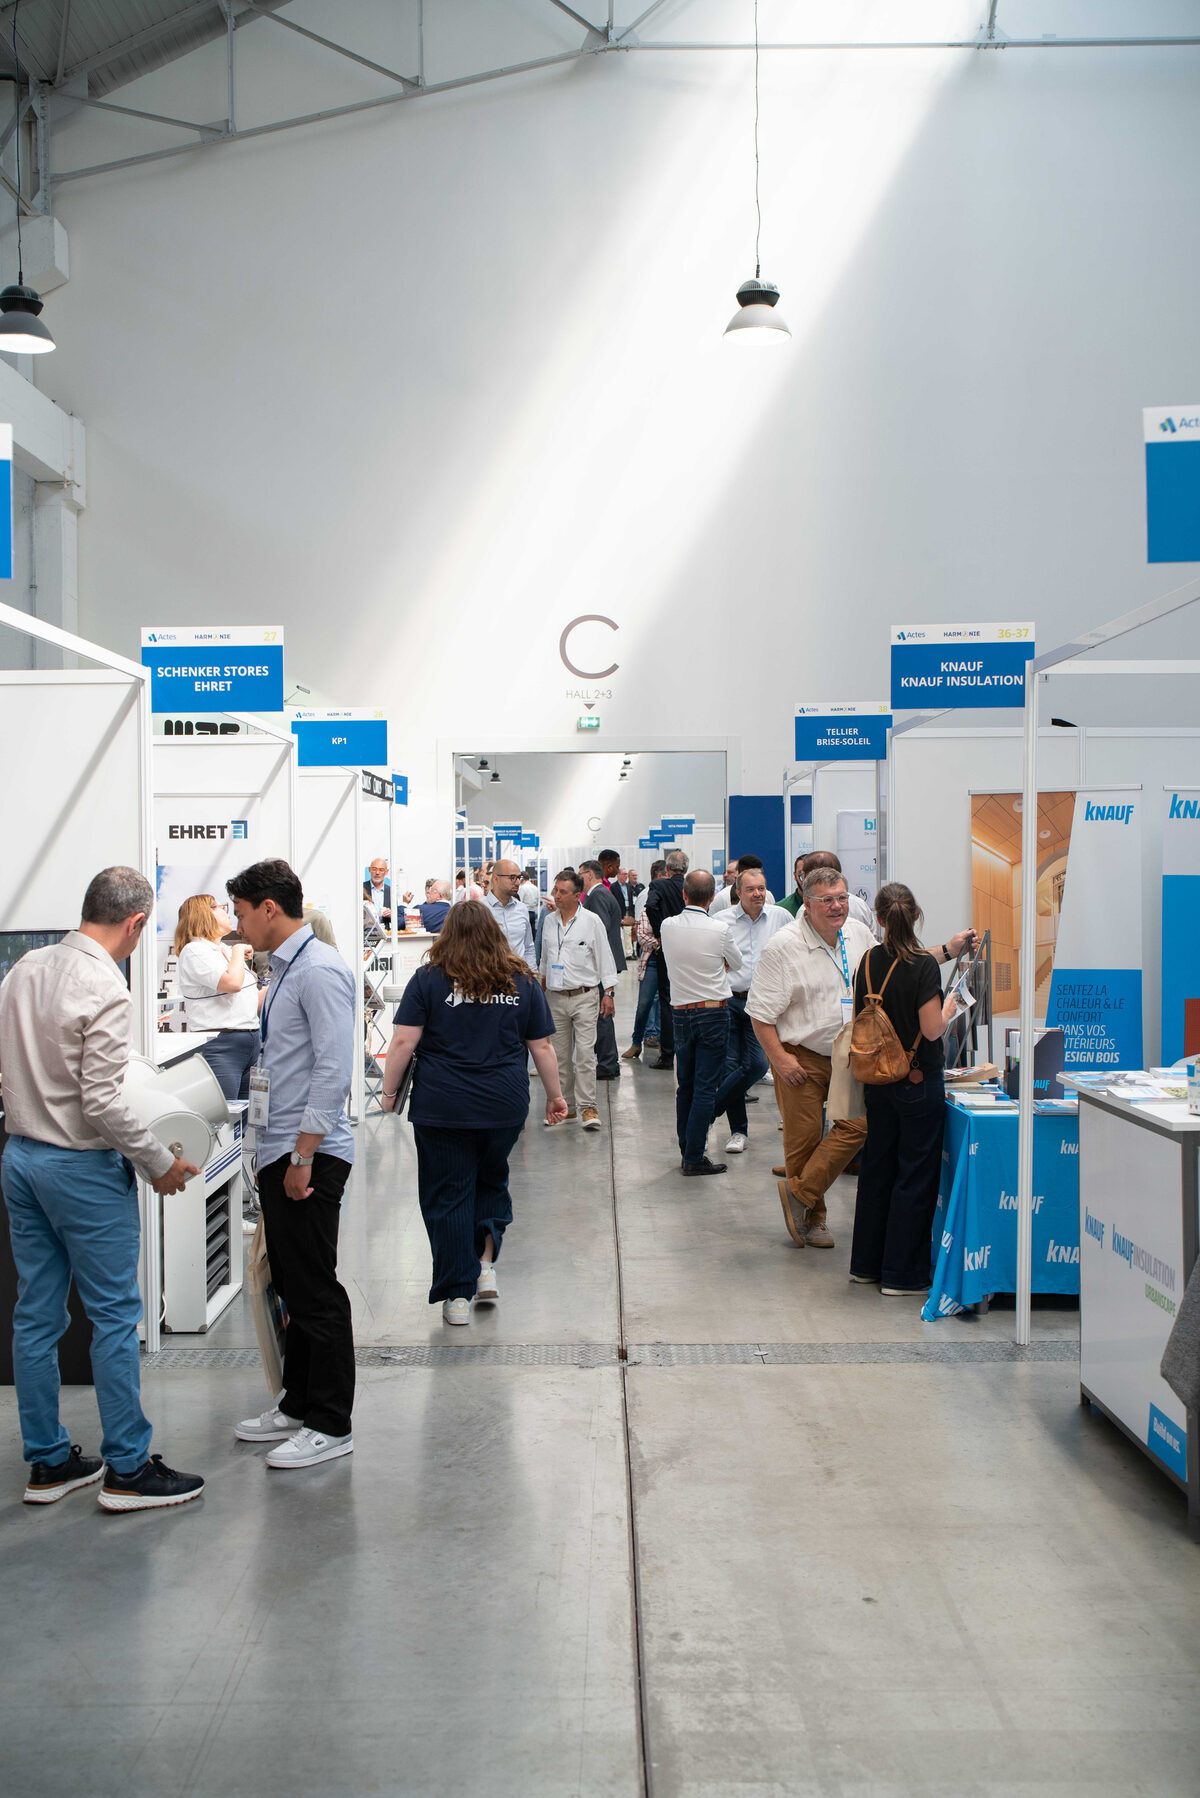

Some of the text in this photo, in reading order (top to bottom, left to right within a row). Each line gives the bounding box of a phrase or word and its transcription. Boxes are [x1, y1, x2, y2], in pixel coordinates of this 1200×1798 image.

[1179, 417, 1200, 429] Act
[158, 633, 177, 641] Actes
[263, 632, 277, 642] 27
[907, 631, 926, 639] Actes
[997, 628, 1029, 639] 36-37
[559, 614, 620, 679] C
[157, 665, 269, 678] SCHENKER STORES
[940, 661, 983, 672] KNAUF
[194, 681, 232, 692] EHRET
[901, 675, 1024, 688] KNAUF INSULATION
[566, 689, 591, 699] HALL
[878, 705, 888, 713] 38
[826, 727, 859, 736] TELLIER
[331, 737, 347, 745] KP1
[816, 737, 871, 746] BRISE-SOLEIL
[1084, 801, 1135, 825] KNAUF
[168, 825, 228, 839] EHRET
[1056, 984, 1107, 996] SENTEZ LA
[1056, 998, 1125, 1010] CHALEUR & LE
[1056, 1011, 1104, 1023] CONFORT
[1086, 1024, 1106, 1036] VOS
[1064, 1051, 1120, 1063] ESIGN BOIS
[1085, 1206, 1105, 1249] KNAUF
[1046, 1240, 1079, 1263] KNA
